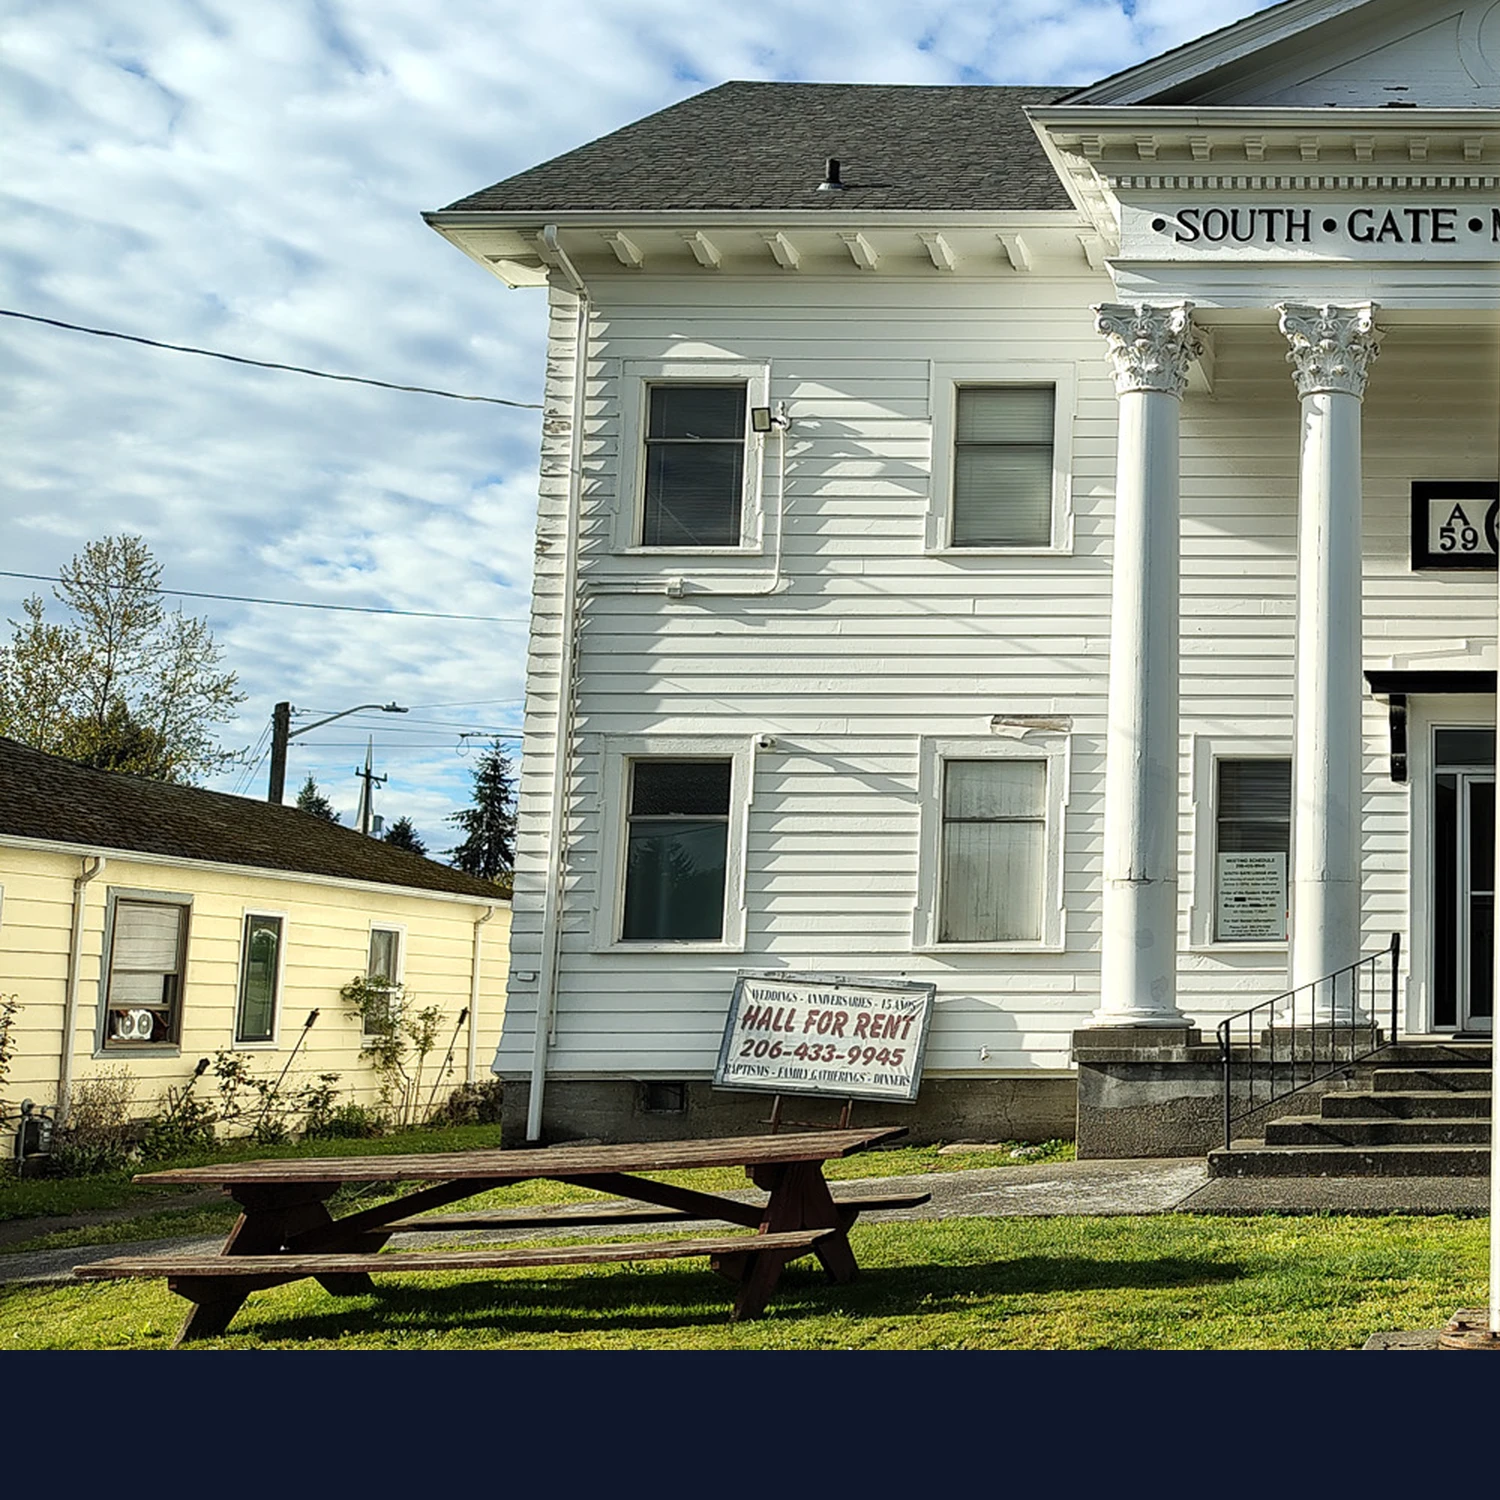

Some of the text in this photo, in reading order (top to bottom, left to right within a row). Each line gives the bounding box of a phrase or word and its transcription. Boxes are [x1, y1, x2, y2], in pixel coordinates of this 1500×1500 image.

[1175, 208, 1312, 243] SOUTH
[1347, 208, 1458, 243] GATE
[1446, 502, 1471, 527] A
[1439, 527, 1479, 552] 59
[752, 989, 798, 1002] WEDDINGS
[808, 993, 873, 1008] ANNIVERSARIES
[741, 1004, 916, 1040] HALL FOR RENT
[740, 1039, 906, 1067] 206-433-9945
[873, 1073, 911, 1087] DINNERS
